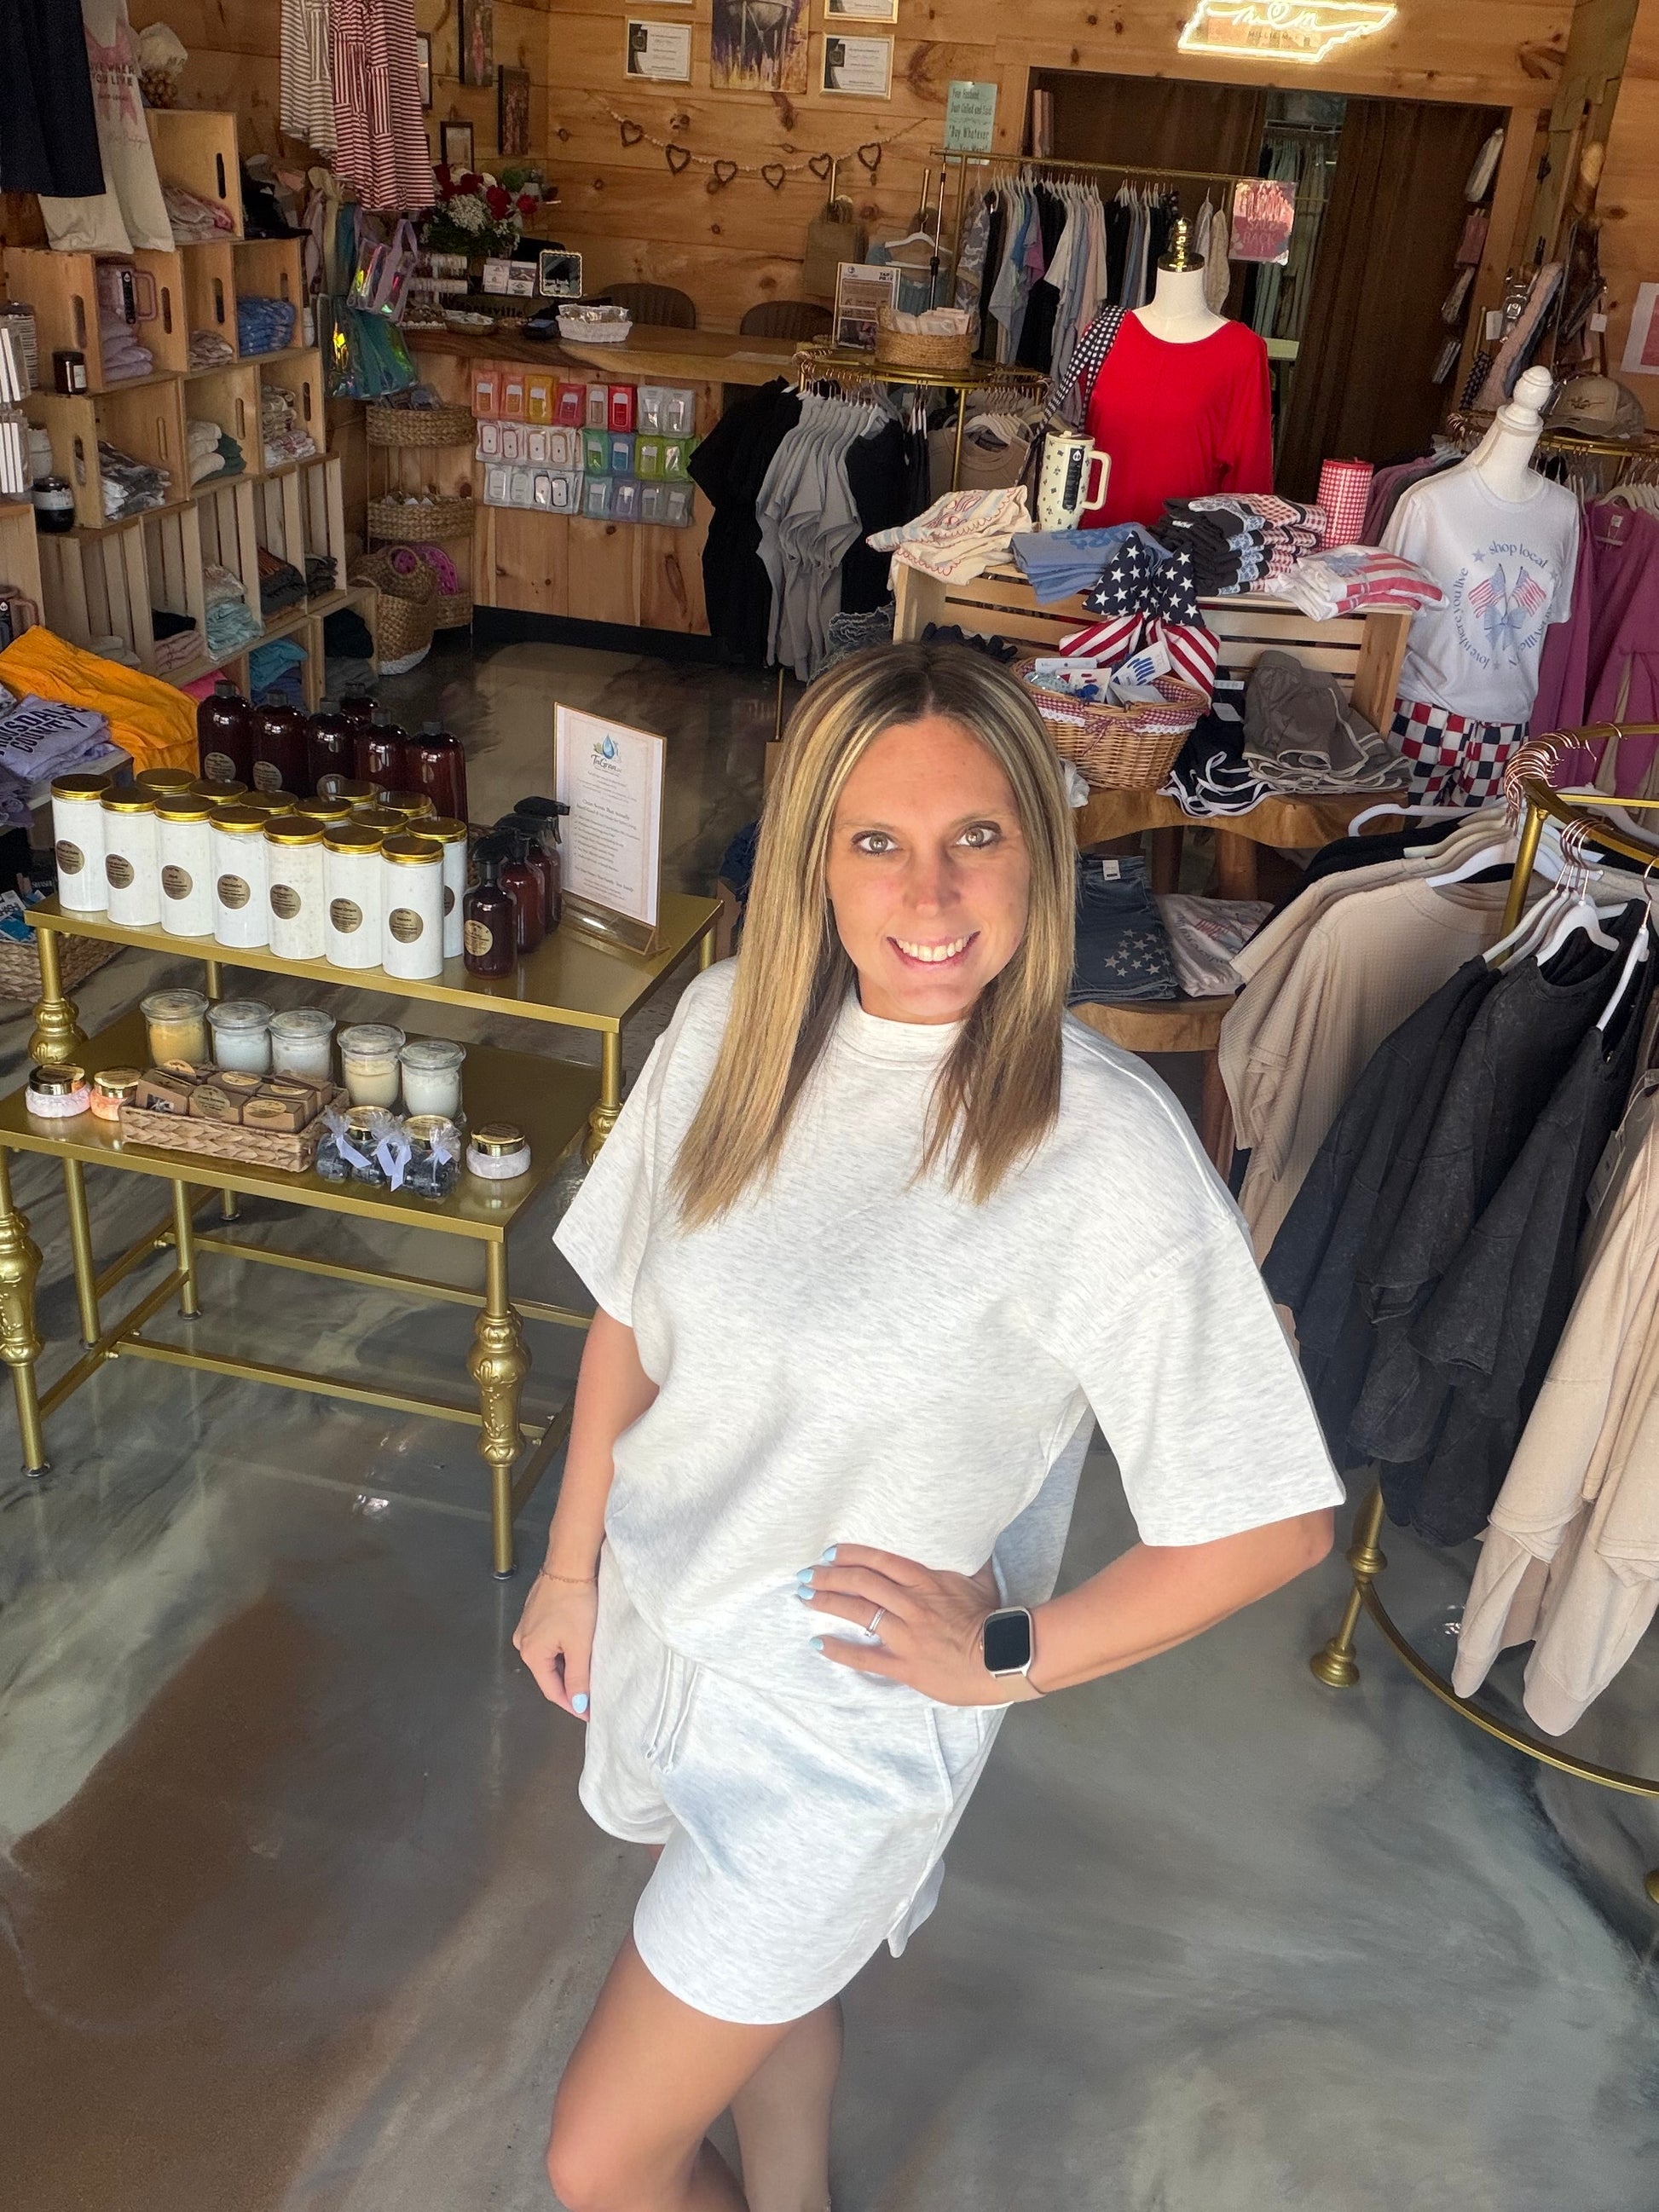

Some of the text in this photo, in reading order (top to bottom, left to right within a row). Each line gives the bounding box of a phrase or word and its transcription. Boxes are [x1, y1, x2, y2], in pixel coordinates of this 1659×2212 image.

[1488, 540, 1548, 569] shop local
[1453, 567, 1469, 589] live
[1454, 615, 1471, 651] where
[1470, 647, 1491, 669] love
[9, 714, 89, 754] COUNTY
